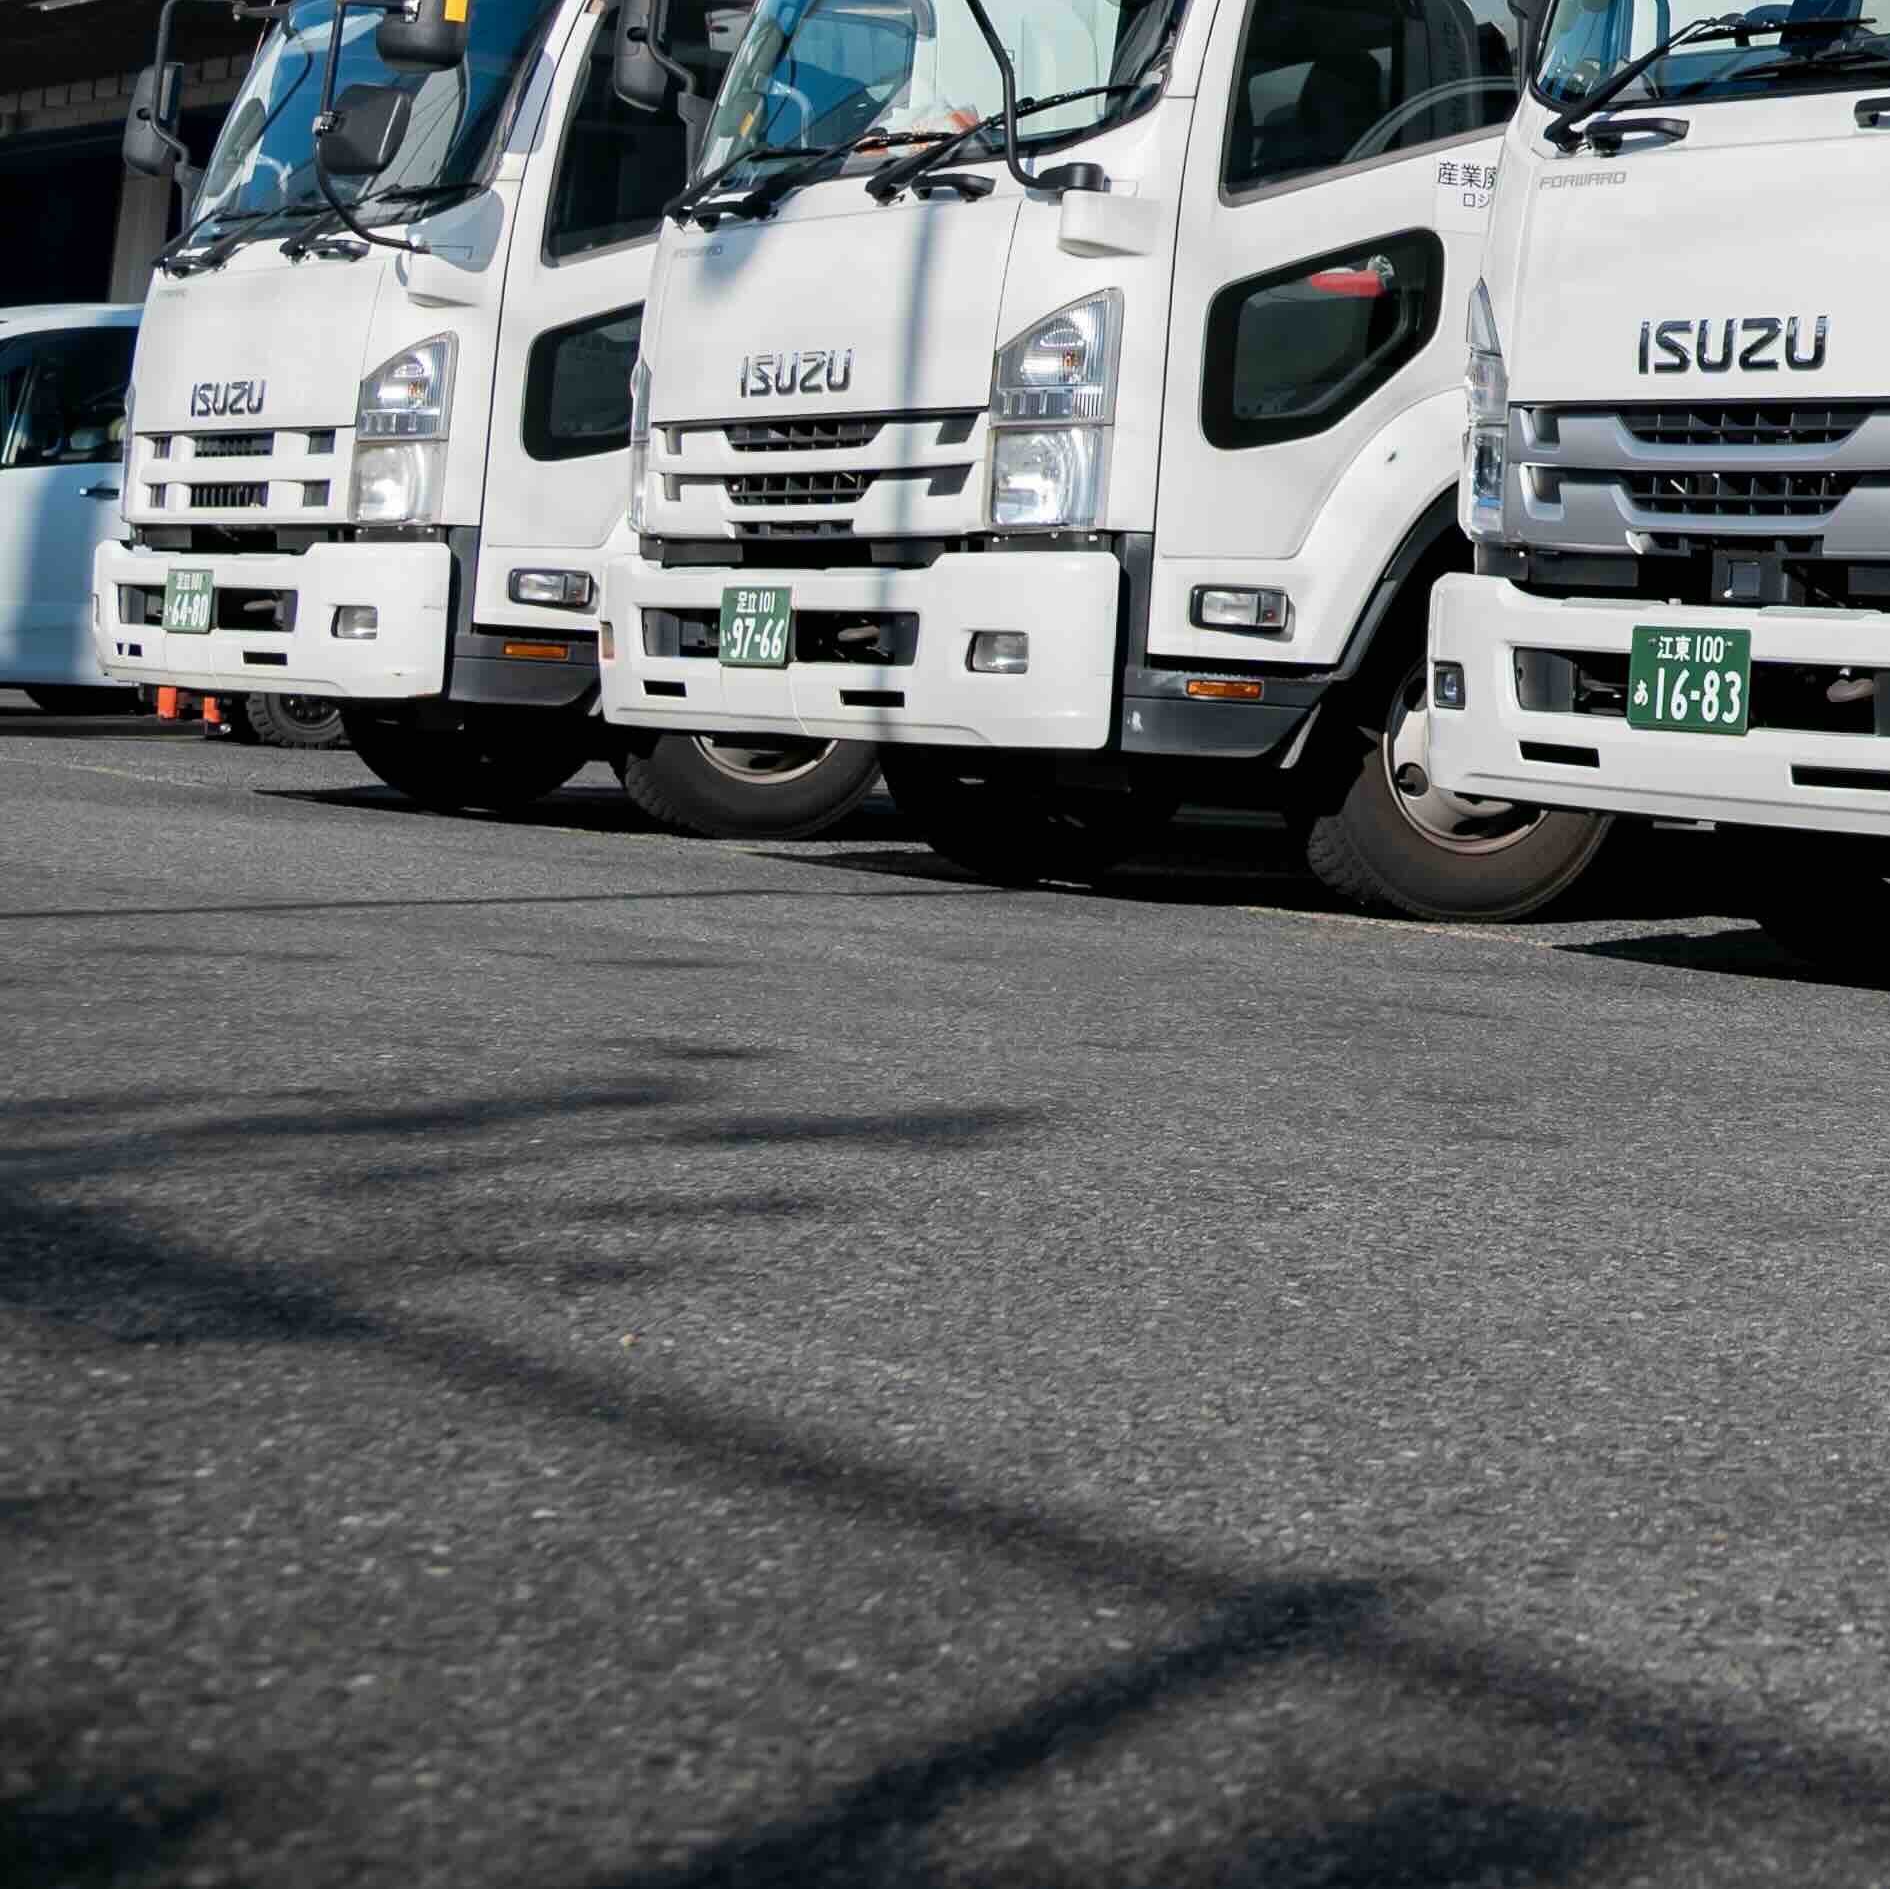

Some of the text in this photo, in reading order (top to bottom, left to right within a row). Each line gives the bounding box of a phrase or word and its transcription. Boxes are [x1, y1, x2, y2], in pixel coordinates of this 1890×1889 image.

[1540, 171, 1626, 190] FORWARD
[1638, 314, 1828, 375] ISUZU
[740, 347, 854, 398] ISUZU
[190, 379, 266, 417] ISUZU
[758, 590, 776, 613] 101
[730, 617, 785, 659] 97-66
[1656, 635, 1724, 663] 江東 100
[1633, 667, 1742, 723] あ 16-83
